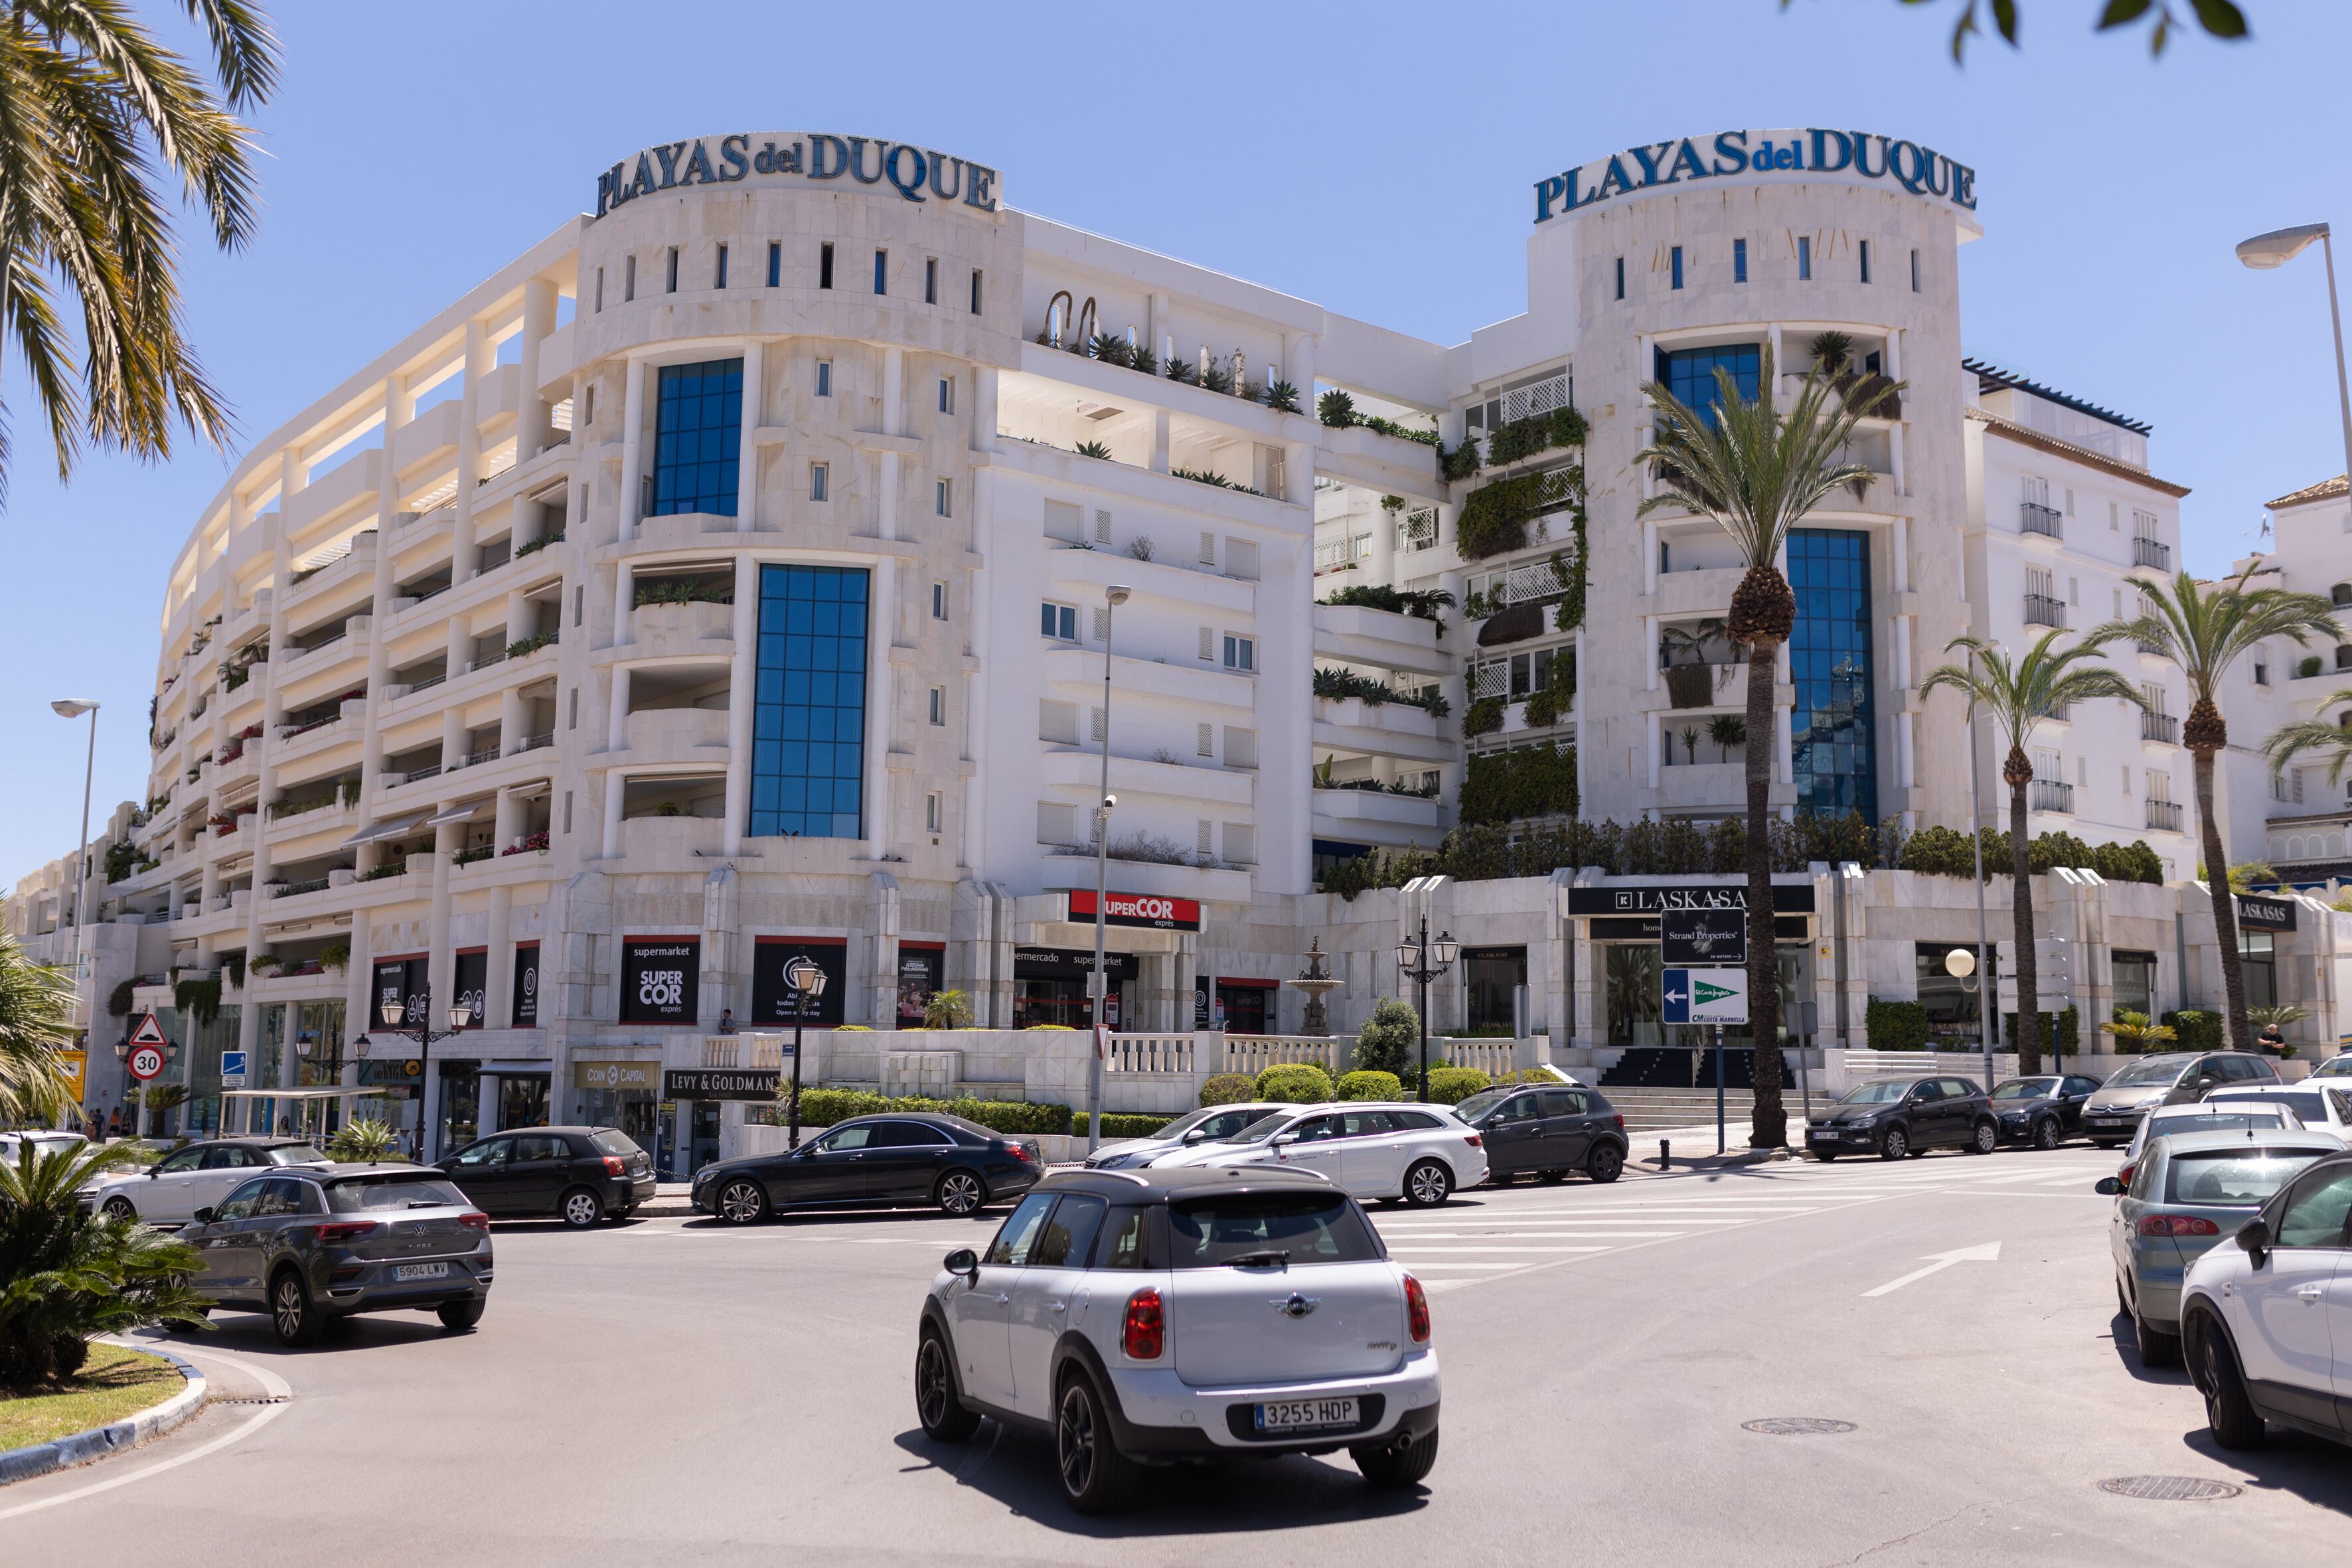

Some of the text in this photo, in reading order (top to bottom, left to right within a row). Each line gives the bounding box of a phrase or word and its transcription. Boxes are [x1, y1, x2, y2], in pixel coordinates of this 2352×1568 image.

[596, 134, 996, 219] PLAYAS del DUQUE
[1533, 127, 1978, 224] PLAYAS del DUQUE
[1636, 890, 1749, 909] LASKASA
[1105, 898, 1173, 919] UPERCOR
[634, 947, 690, 958] supermarket
[1013, 953, 1059, 963] ermercado
[1073, 956, 1122, 967] superarket
[640, 971, 683, 984] SUPER
[639, 984, 682, 1004] COR
[661, 1005, 682, 1014] exprés
[137, 1056, 157, 1070] 30
[588, 1068, 646, 1081] COIN CAPITAL
[672, 1073, 774, 1091] LEVY & GOLDMAN
[399, 1265, 445, 1277] 5904 LWV
[1268, 1401, 1352, 1425] 3255 HDP
